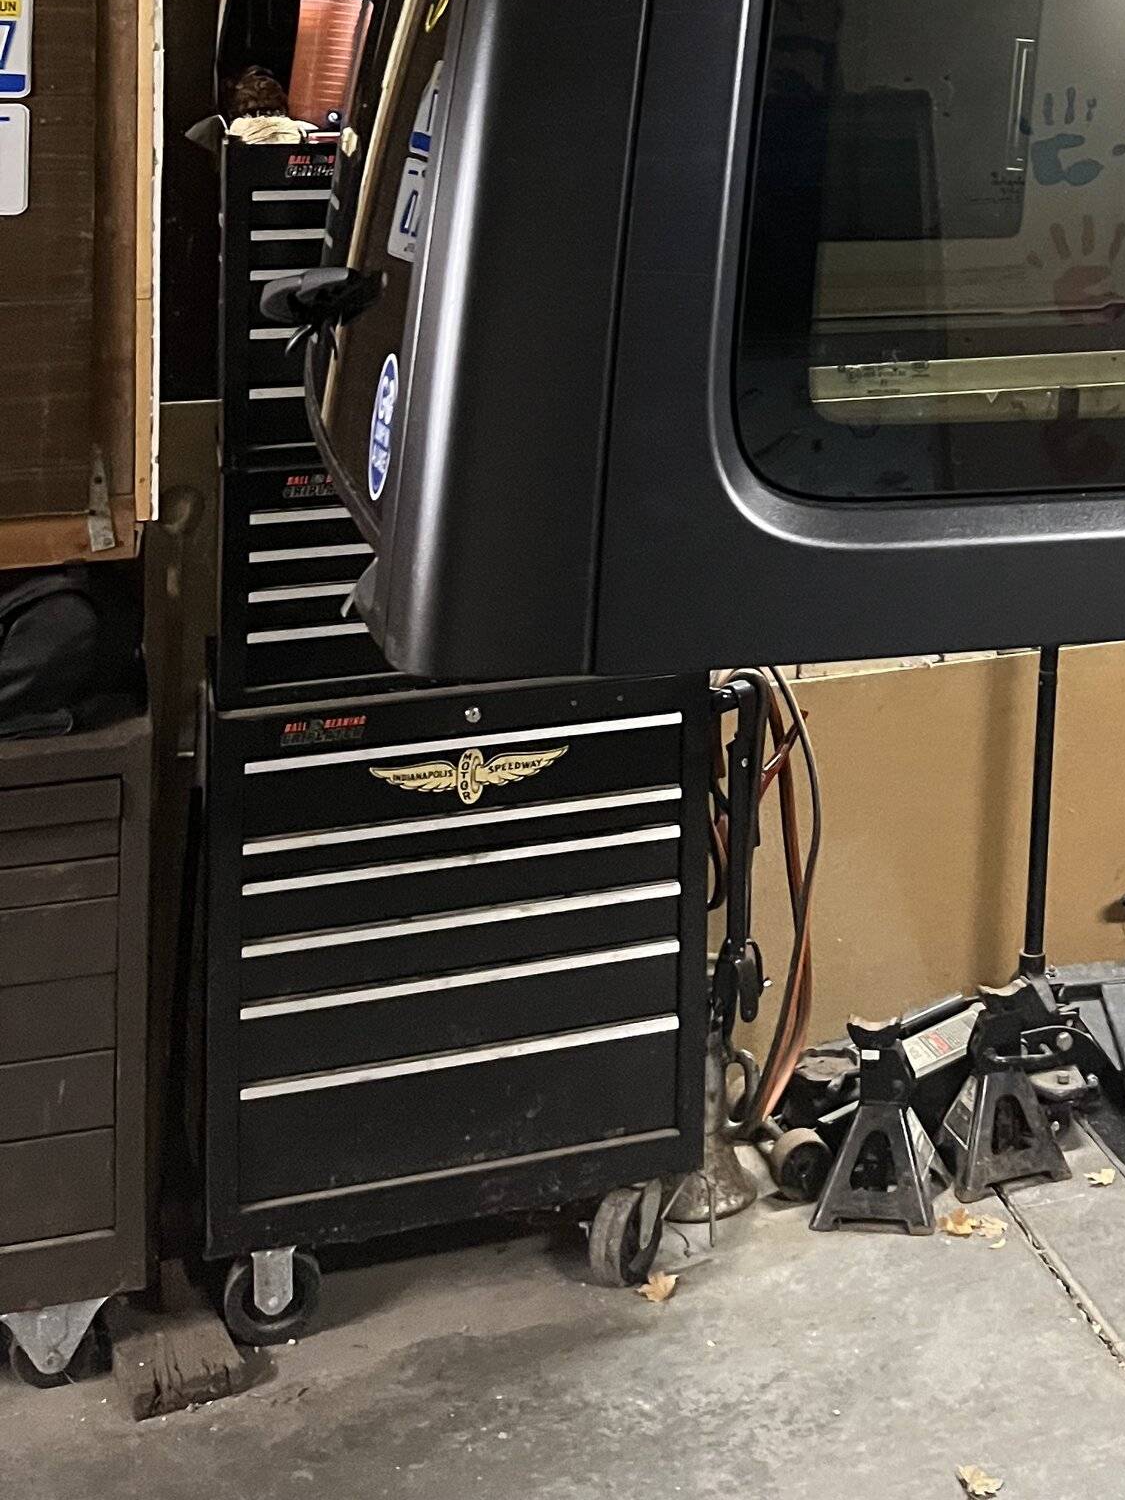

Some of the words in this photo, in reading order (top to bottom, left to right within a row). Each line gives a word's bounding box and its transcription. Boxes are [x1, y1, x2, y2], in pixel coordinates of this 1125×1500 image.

[392, 769, 454, 782] INDIANAPOLIS
[459, 752, 473, 801] MOTOR
[488, 758, 544, 774] SPEEDWAY
